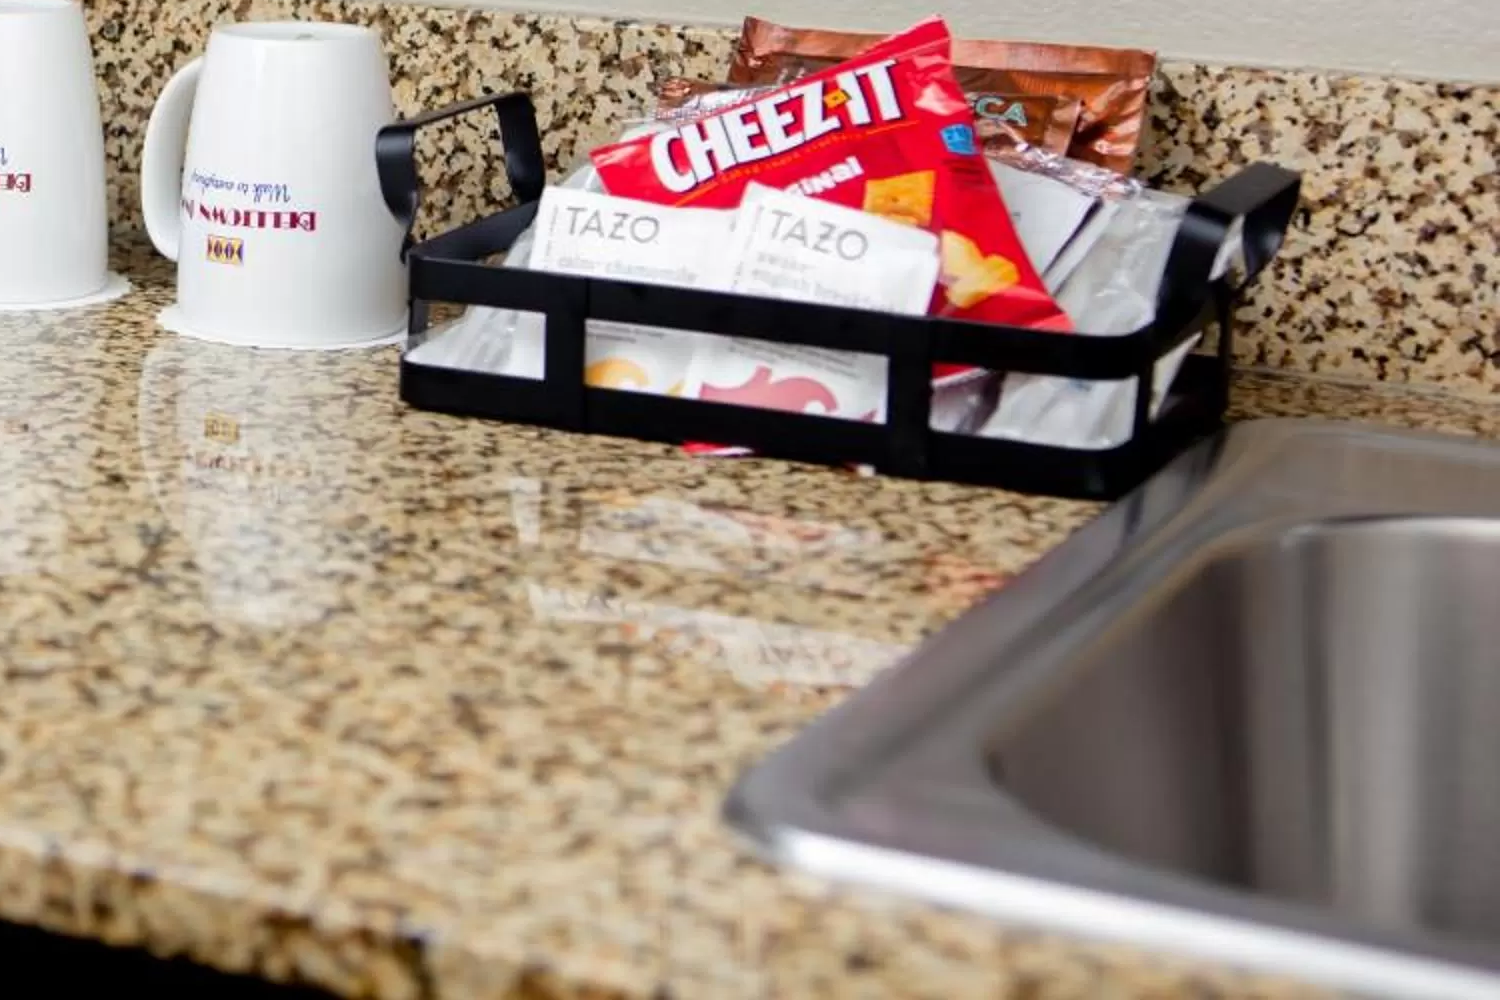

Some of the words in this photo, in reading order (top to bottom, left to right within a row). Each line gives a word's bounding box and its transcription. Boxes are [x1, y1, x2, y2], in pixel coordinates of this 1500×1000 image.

[237, 182, 249, 194] to
[253, 183, 291, 203] Walk
[199, 203, 316, 231] BELLTOWN
[565, 206, 660, 244] TAZO
[771, 209, 869, 261] TAZO
